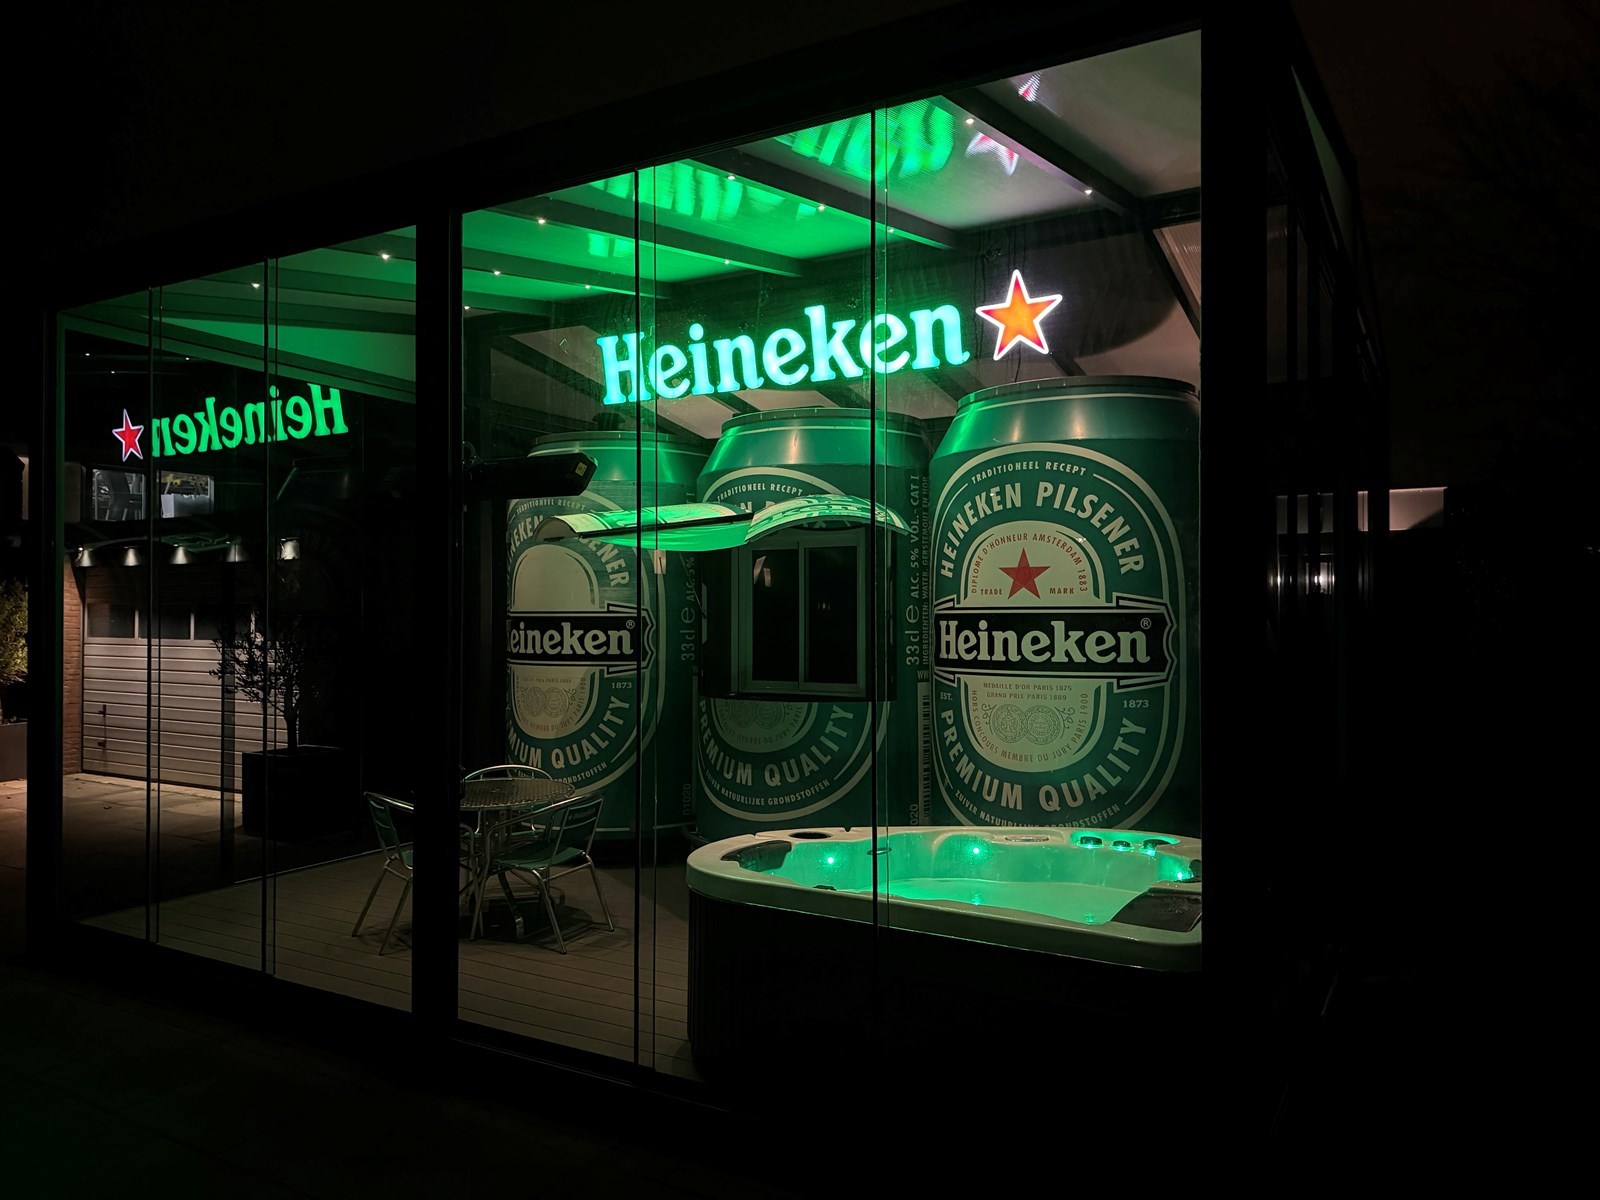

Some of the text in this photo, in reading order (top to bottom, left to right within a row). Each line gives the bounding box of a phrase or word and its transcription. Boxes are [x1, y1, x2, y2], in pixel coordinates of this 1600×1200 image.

[596, 304, 970, 405] Heineken
[971, 461, 1087, 484] TRADITIONEEL RECEPT
[717, 482, 803, 502] TRADITIONEEL RECEPT
[910, 483, 919, 506] CAT
[940, 481, 1145, 578] HEINEKEN PILSENER
[910, 548, 919, 568] 5%
[972, 533, 1088, 594] DIPLOME D'HONNEUR AMSTERDAM 1883
[910, 572, 919, 598] ALC.
[506, 621, 634, 655] eineken
[1122, 699, 1149, 709] 1873
[551, 695, 630, 769] QUALITY
[699, 697, 854, 787] PREMIUM QUALITY
[1001, 750, 1033, 762] MEMBRE
[1037, 753, 1049, 762] DU
[1053, 743, 1072, 759] JURY
[1071, 719, 1087, 744] PARIS
[1080, 693, 1088, 715] 1900
[940, 709, 1147, 812] PREMIUM QUALITY
[768, 778, 830, 806] GRONDSTOFFEN
[955, 788, 978, 815] ZUIVER
